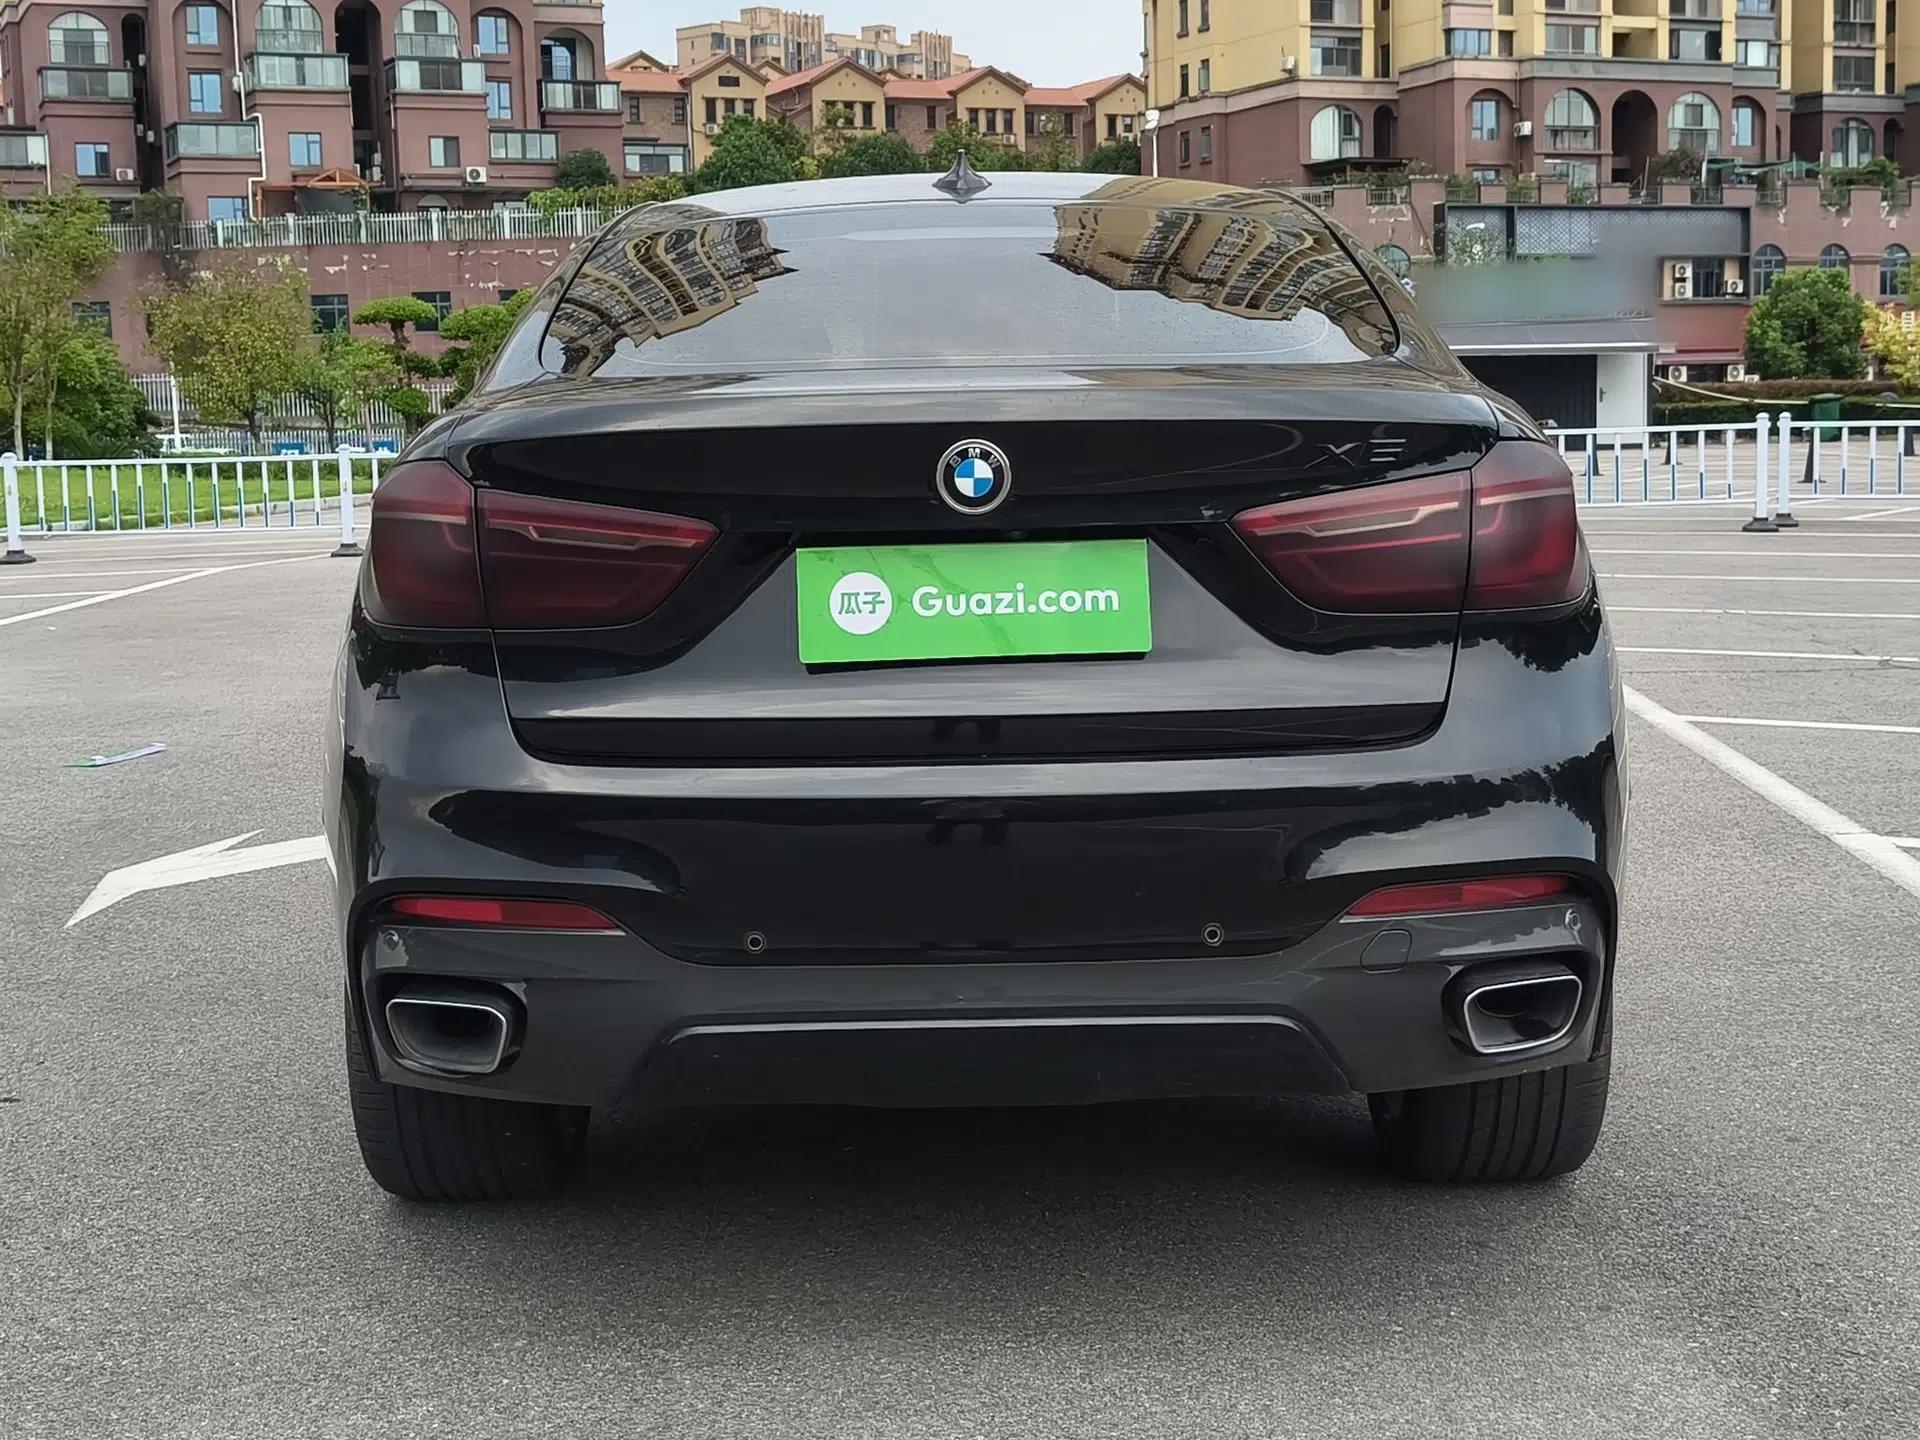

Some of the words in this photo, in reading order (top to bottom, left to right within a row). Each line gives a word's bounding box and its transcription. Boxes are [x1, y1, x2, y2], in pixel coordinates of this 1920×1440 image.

[949, 447, 1001, 469] BMW
[837, 591, 886, 615] 瓜子
[912, 582, 1120, 618] Guazi.com
